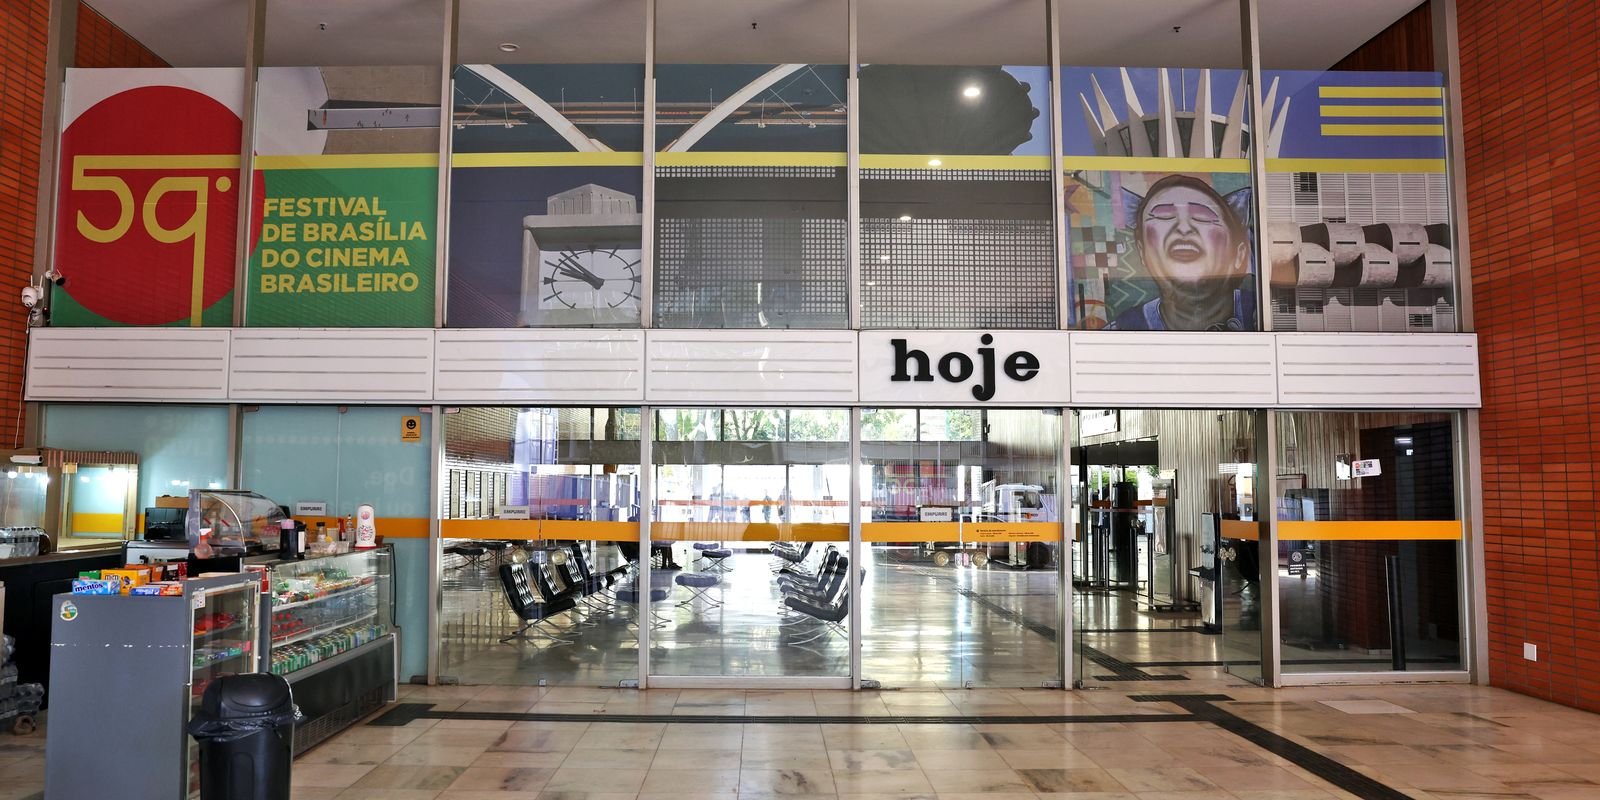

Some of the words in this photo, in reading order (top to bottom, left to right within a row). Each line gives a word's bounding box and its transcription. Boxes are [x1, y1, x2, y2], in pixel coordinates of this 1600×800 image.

[263, 197, 386, 217] FESTIVAL
[262, 223, 297, 242] DE
[303, 217, 427, 241] BRASÍLIA
[261, 249, 300, 268] DO
[305, 247, 409, 267] CINEMA
[260, 272, 419, 293] BRASILEIRO
[890, 333, 1040, 401] hoje
[74, 583, 104, 593] mentos
